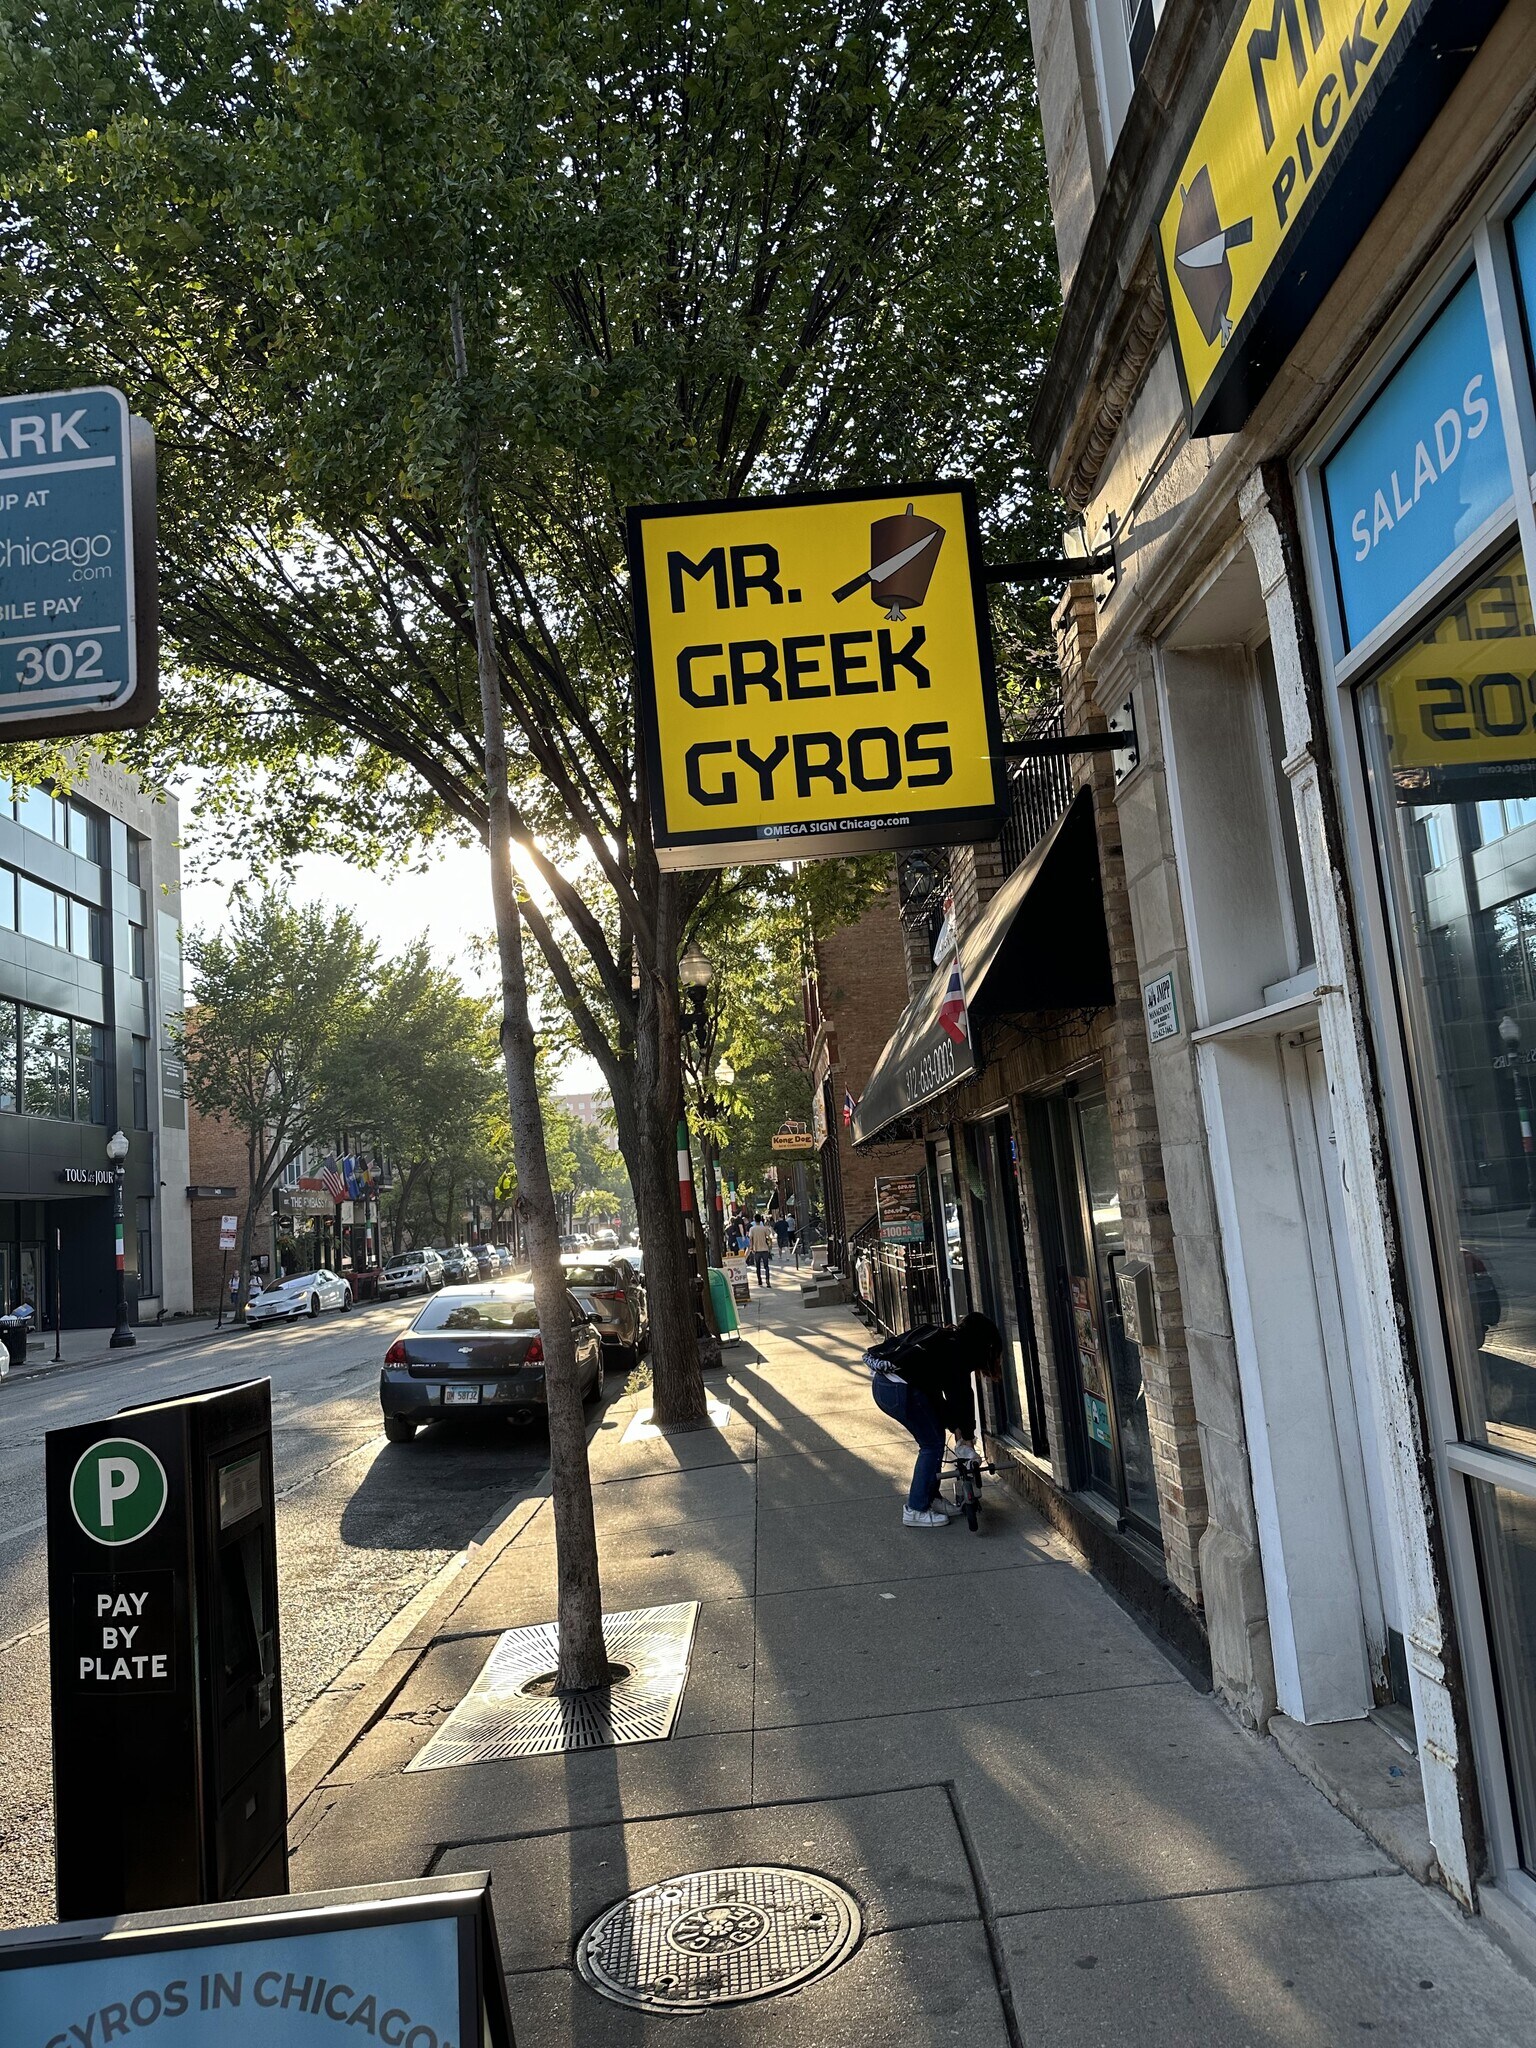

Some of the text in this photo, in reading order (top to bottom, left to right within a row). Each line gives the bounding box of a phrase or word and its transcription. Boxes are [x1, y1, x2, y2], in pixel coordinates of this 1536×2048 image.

[1352, 374, 1489, 561] SALADS
[24, 490, 50, 508] AT
[68, 566, 112, 582] .com
[667, 543, 802, 613] MR.
[43, 597, 82, 616] PAY
[16, 640, 104, 685] 302
[677, 626, 931, 708] GREEK
[685, 721, 953, 806] GYROS
[99, 788, 124, 814] FAME
[763, 815, 910, 837] OMEGA SIGN Chicago.com
[773, 1137, 794, 1145] Kong
[795, 1135, 812, 1143] Dog
[65, 1168, 87, 1182] TOUS
[95, 1170, 114, 1186] JOUR
[291, 1196, 303, 1208] THE
[99, 1457, 140, 1527] P
[97, 1592, 149, 1617] PAY
[103, 1626, 139, 1649] BY
[80, 1655, 168, 1680] PLATE
[200, 1971, 242, 2011] IN
